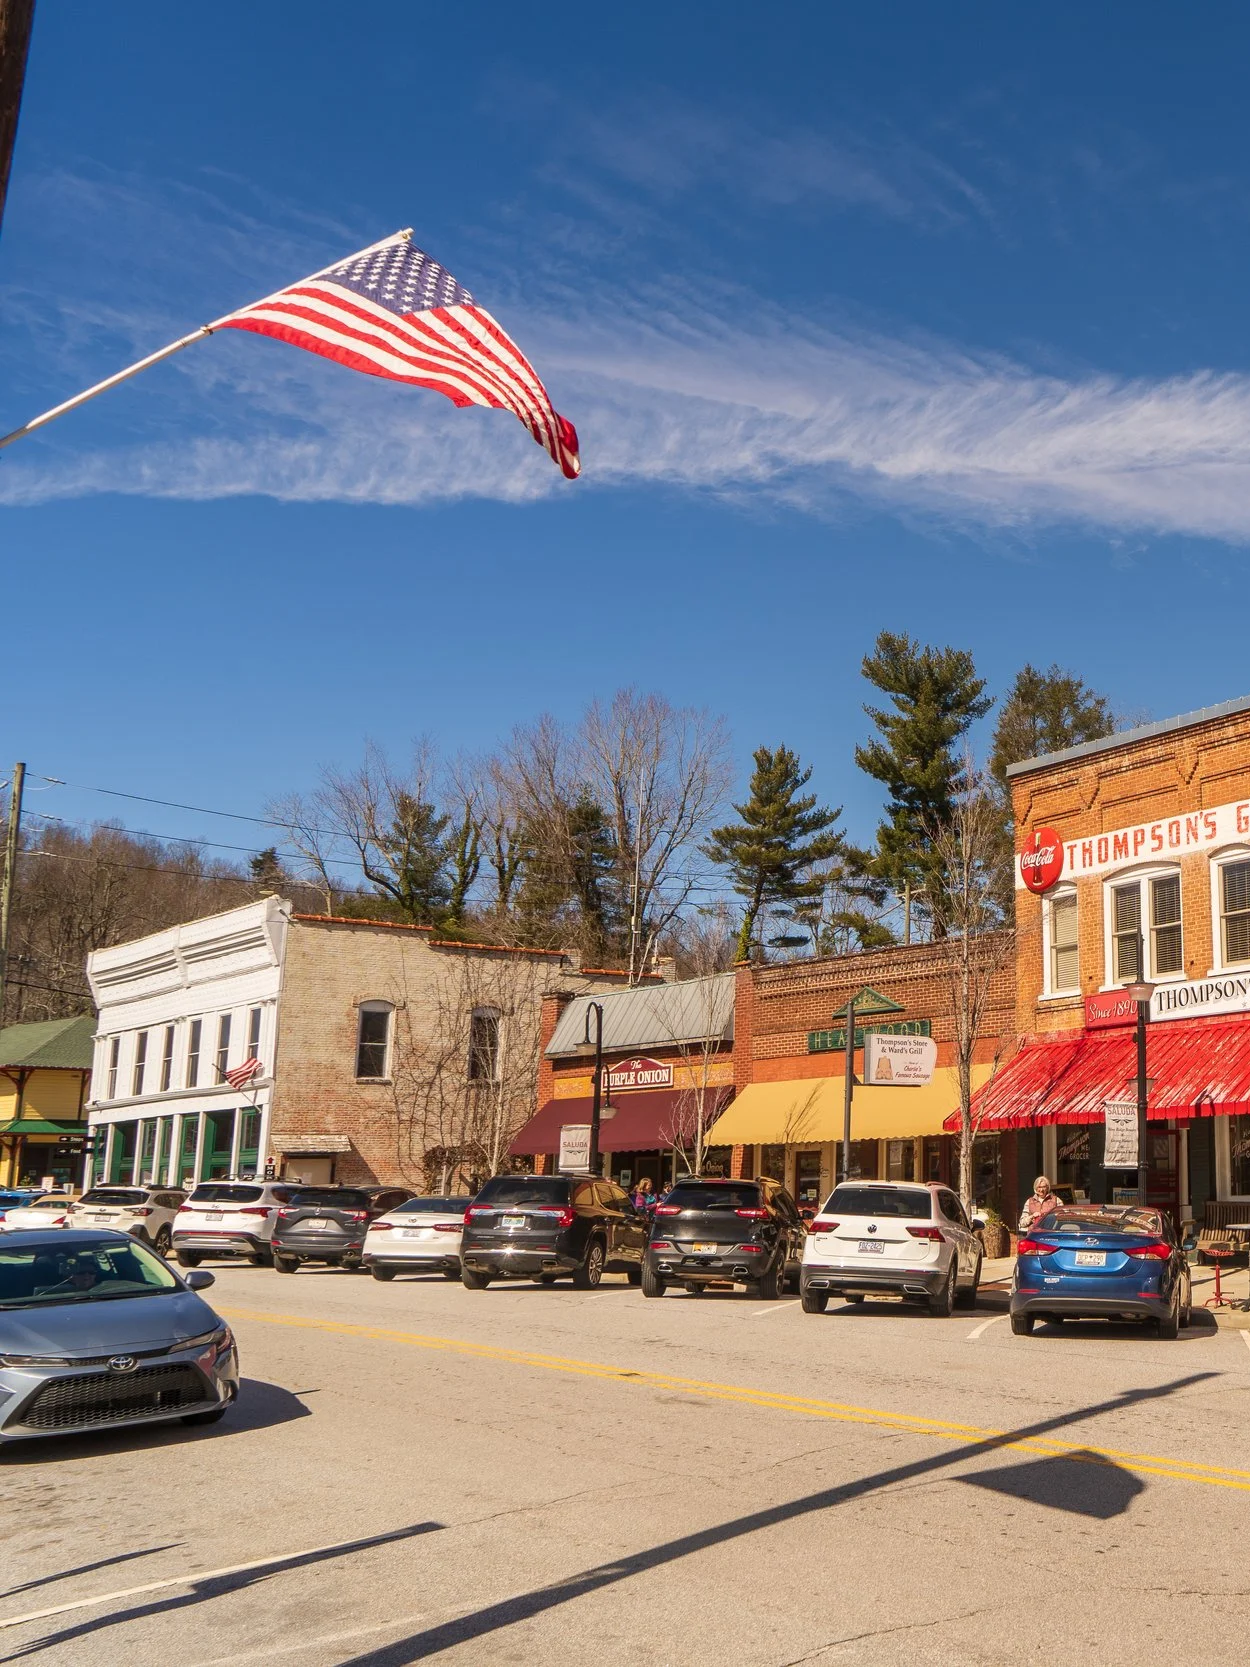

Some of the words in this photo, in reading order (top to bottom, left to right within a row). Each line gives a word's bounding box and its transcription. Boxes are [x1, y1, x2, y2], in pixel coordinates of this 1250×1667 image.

[1067, 811, 1217, 870] THOMPSON'S
[1089, 1002, 1112, 1022] Since
[1113, 999, 1139, 1018] 1890
[814, 1022, 921, 1049] HEATWOOD
[876, 1037, 912, 1048] Thompson's
[888, 1046, 908, 1054] Ward's
[908, 1047, 923, 1055] Grill
[630, 1060, 643, 1070] The
[637, 1069, 669, 1084] ONION
[1108, 1105, 1136, 1116] SALUDA
